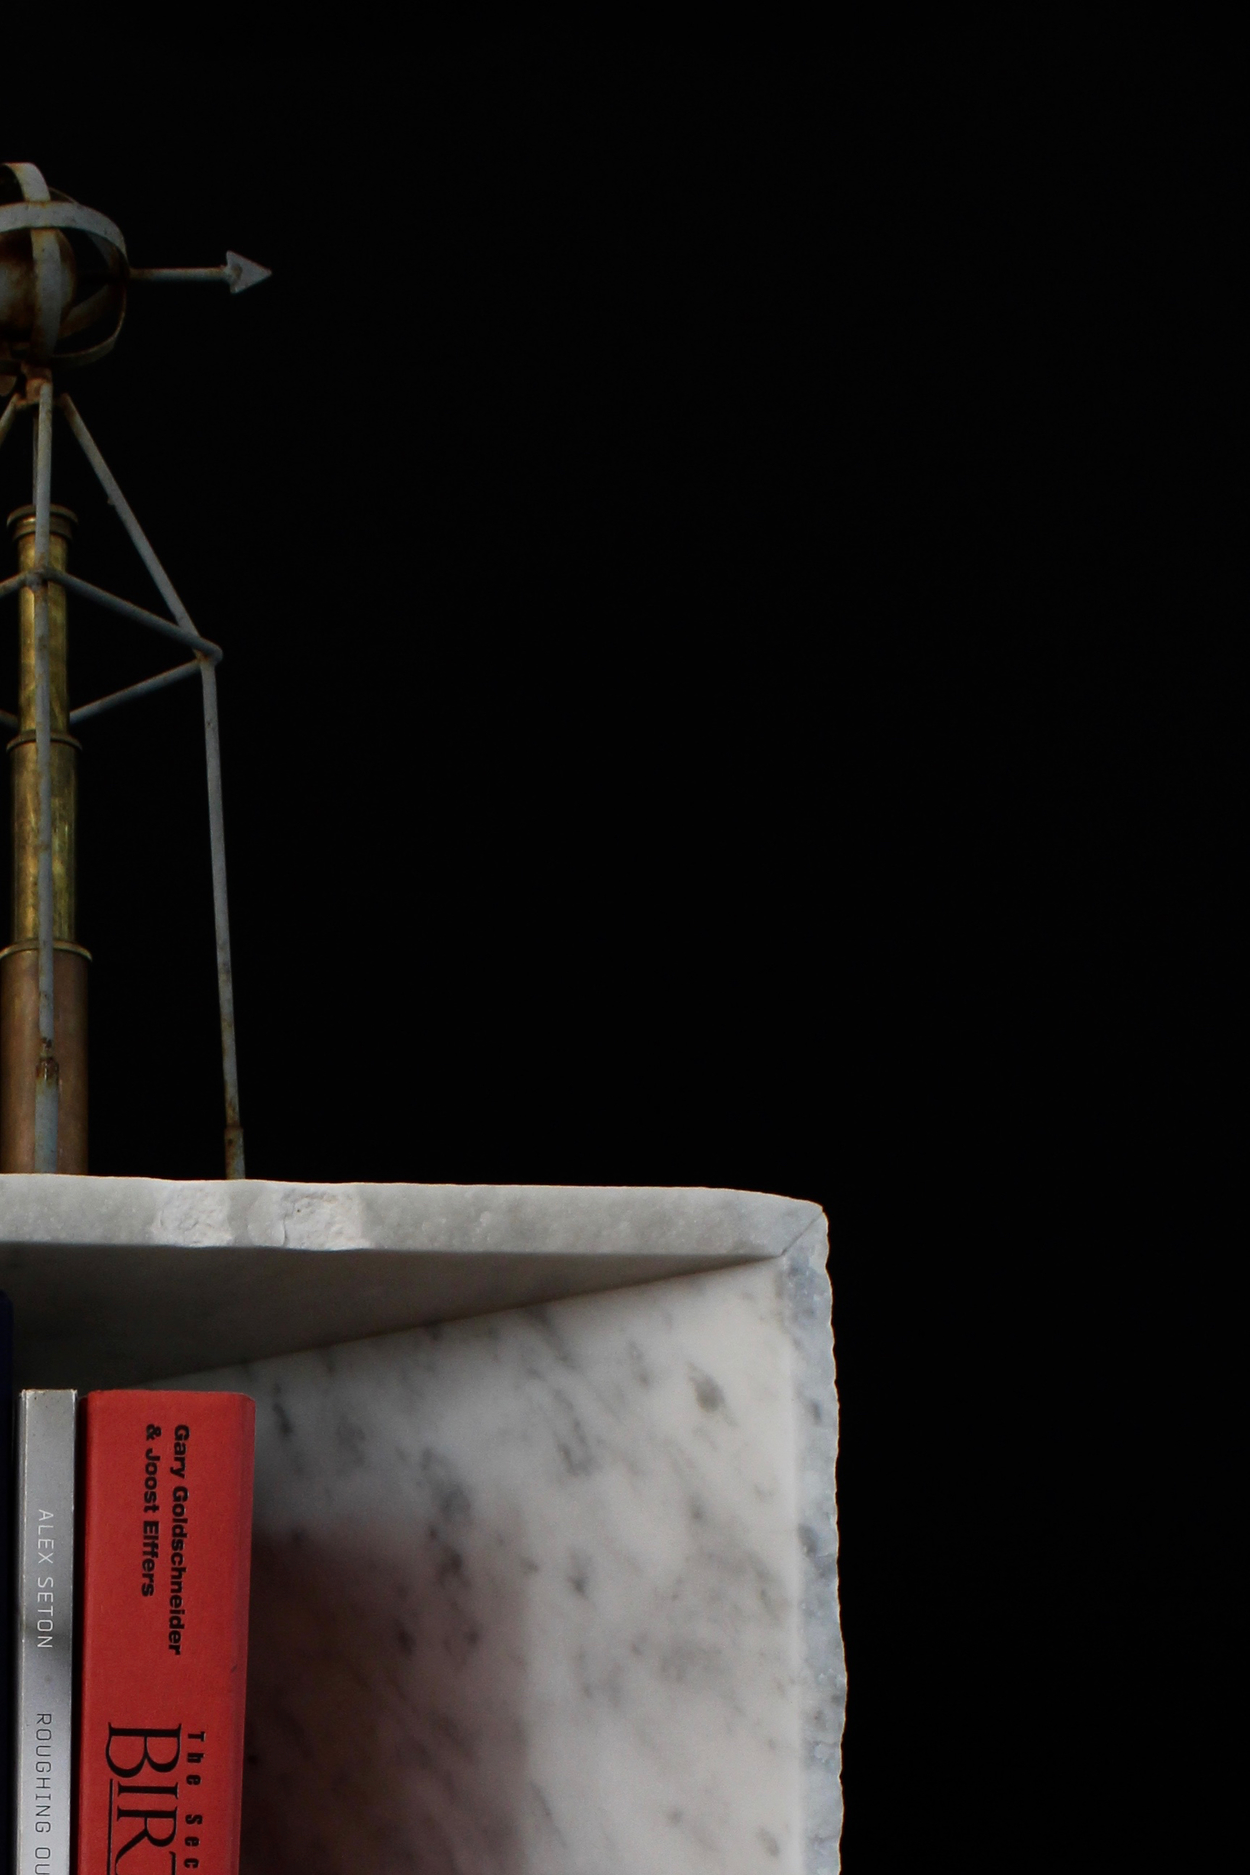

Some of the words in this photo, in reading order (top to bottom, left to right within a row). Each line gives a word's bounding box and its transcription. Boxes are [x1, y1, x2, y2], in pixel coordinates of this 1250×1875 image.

[146, 1423, 162, 1441] &
[170, 1424, 190, 1479] Gary
[143, 1448, 160, 1513] Joost
[37, 1509, 54, 1565] ALEX
[141, 1520, 159, 1598] Elffers
[167, 1486, 189, 1656] Goldschneider
[37, 1576, 54, 1650] SETON
[35, 1713, 53, 1835] ROUGHING
[186, 1730, 206, 1787] The
